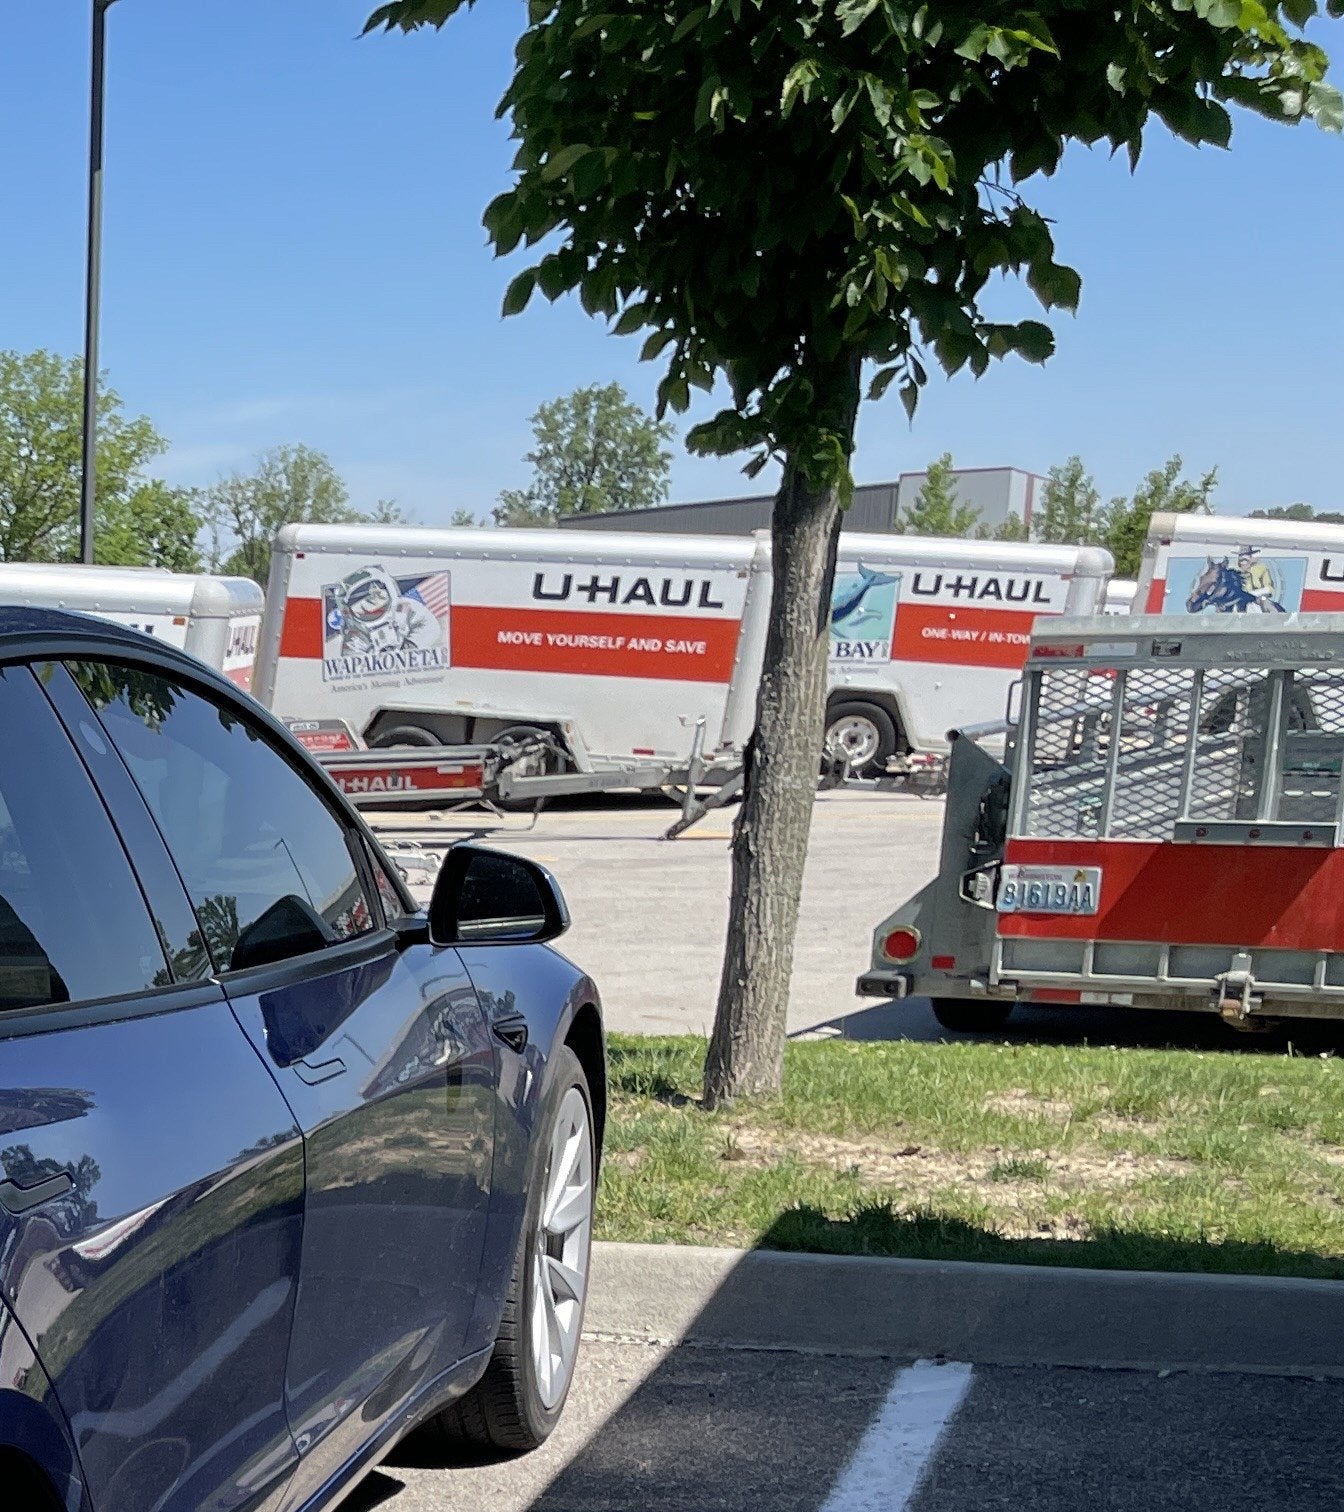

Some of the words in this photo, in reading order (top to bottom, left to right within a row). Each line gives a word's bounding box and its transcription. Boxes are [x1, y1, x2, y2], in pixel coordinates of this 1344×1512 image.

[532, 572, 724, 609] U-HAUL
[912, 572, 1052, 604] U-HAUL
[496, 630, 544, 646] MOVE
[546, 632, 625, 650] YOURSELF
[626, 636, 663, 652] AND
[664, 638, 707, 655] SAVE
[921, 627, 979, 642] ONE-WAY
[324, 648, 441, 677] WAPAKONETA
